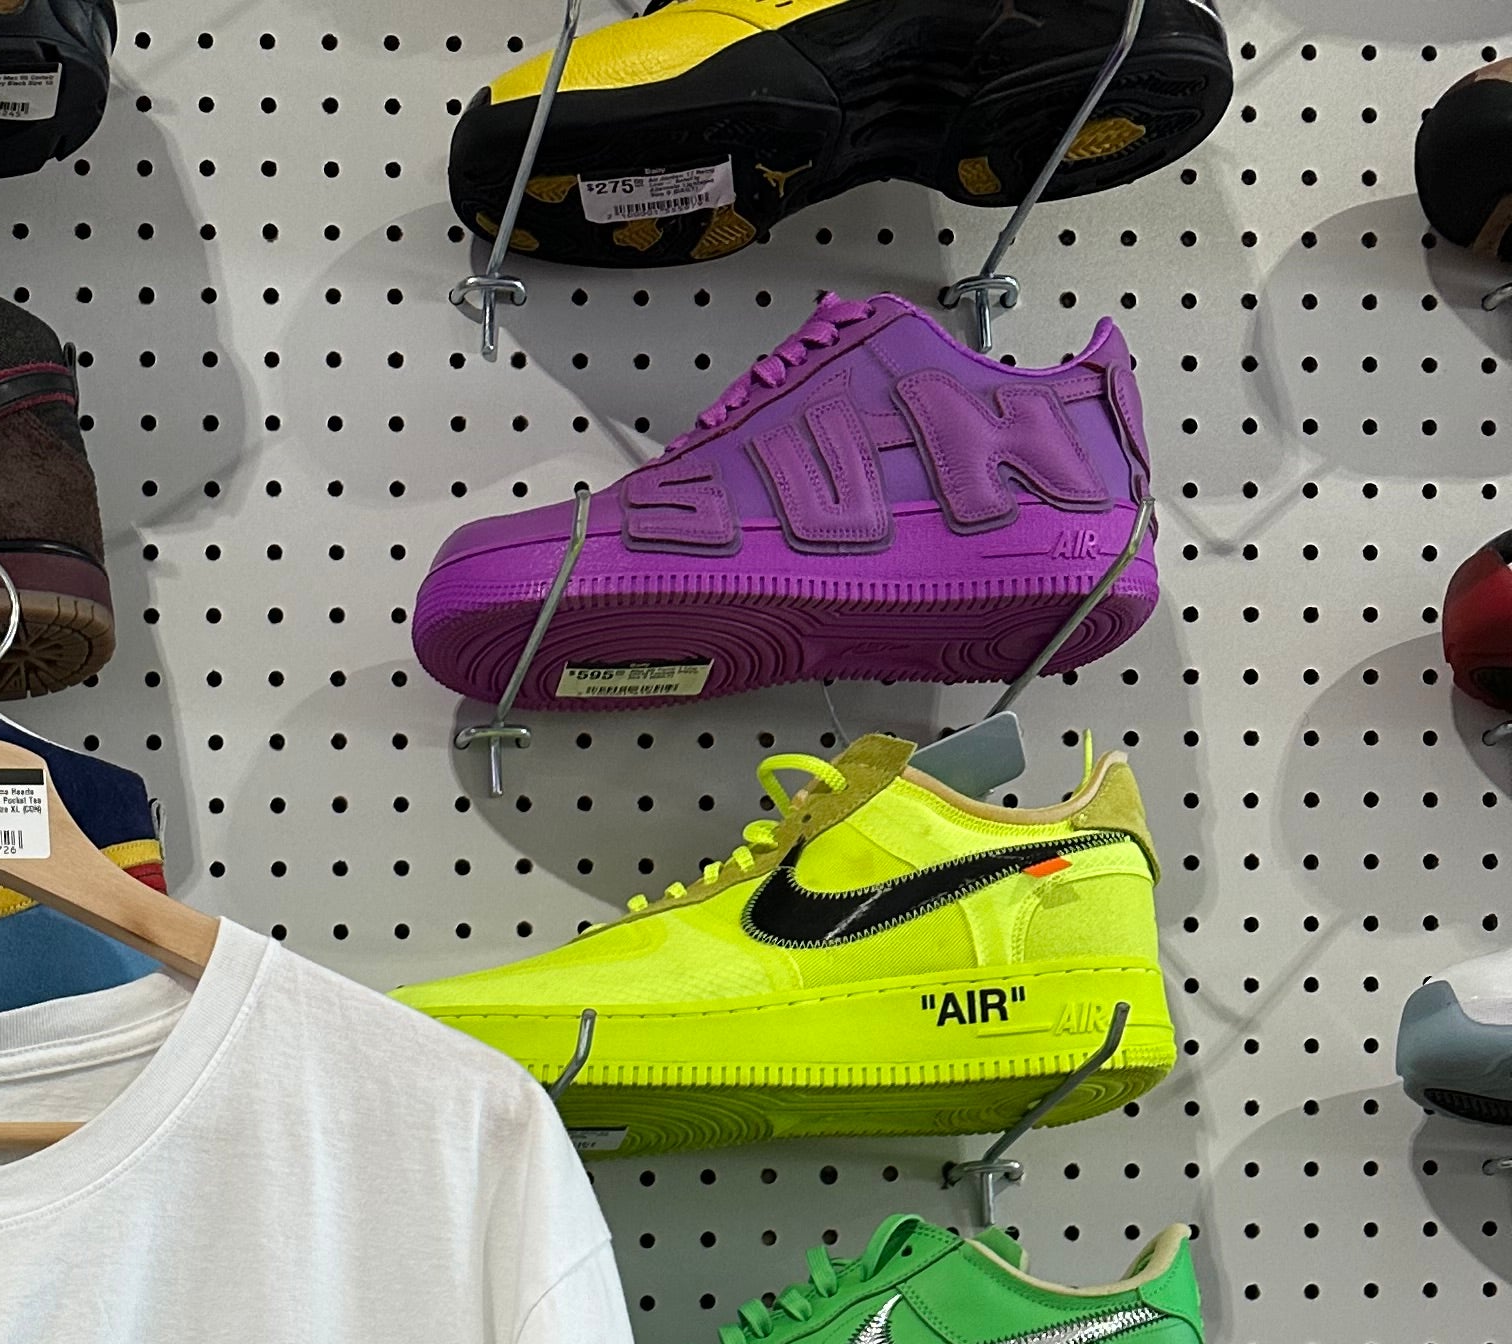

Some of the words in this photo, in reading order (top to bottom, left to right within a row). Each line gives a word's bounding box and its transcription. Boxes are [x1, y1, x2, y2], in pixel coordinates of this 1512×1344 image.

[586, 179, 634, 195] $275
[1050, 529, 1098, 561] AIR
[921, 985, 1026, 1027] "AIR"
